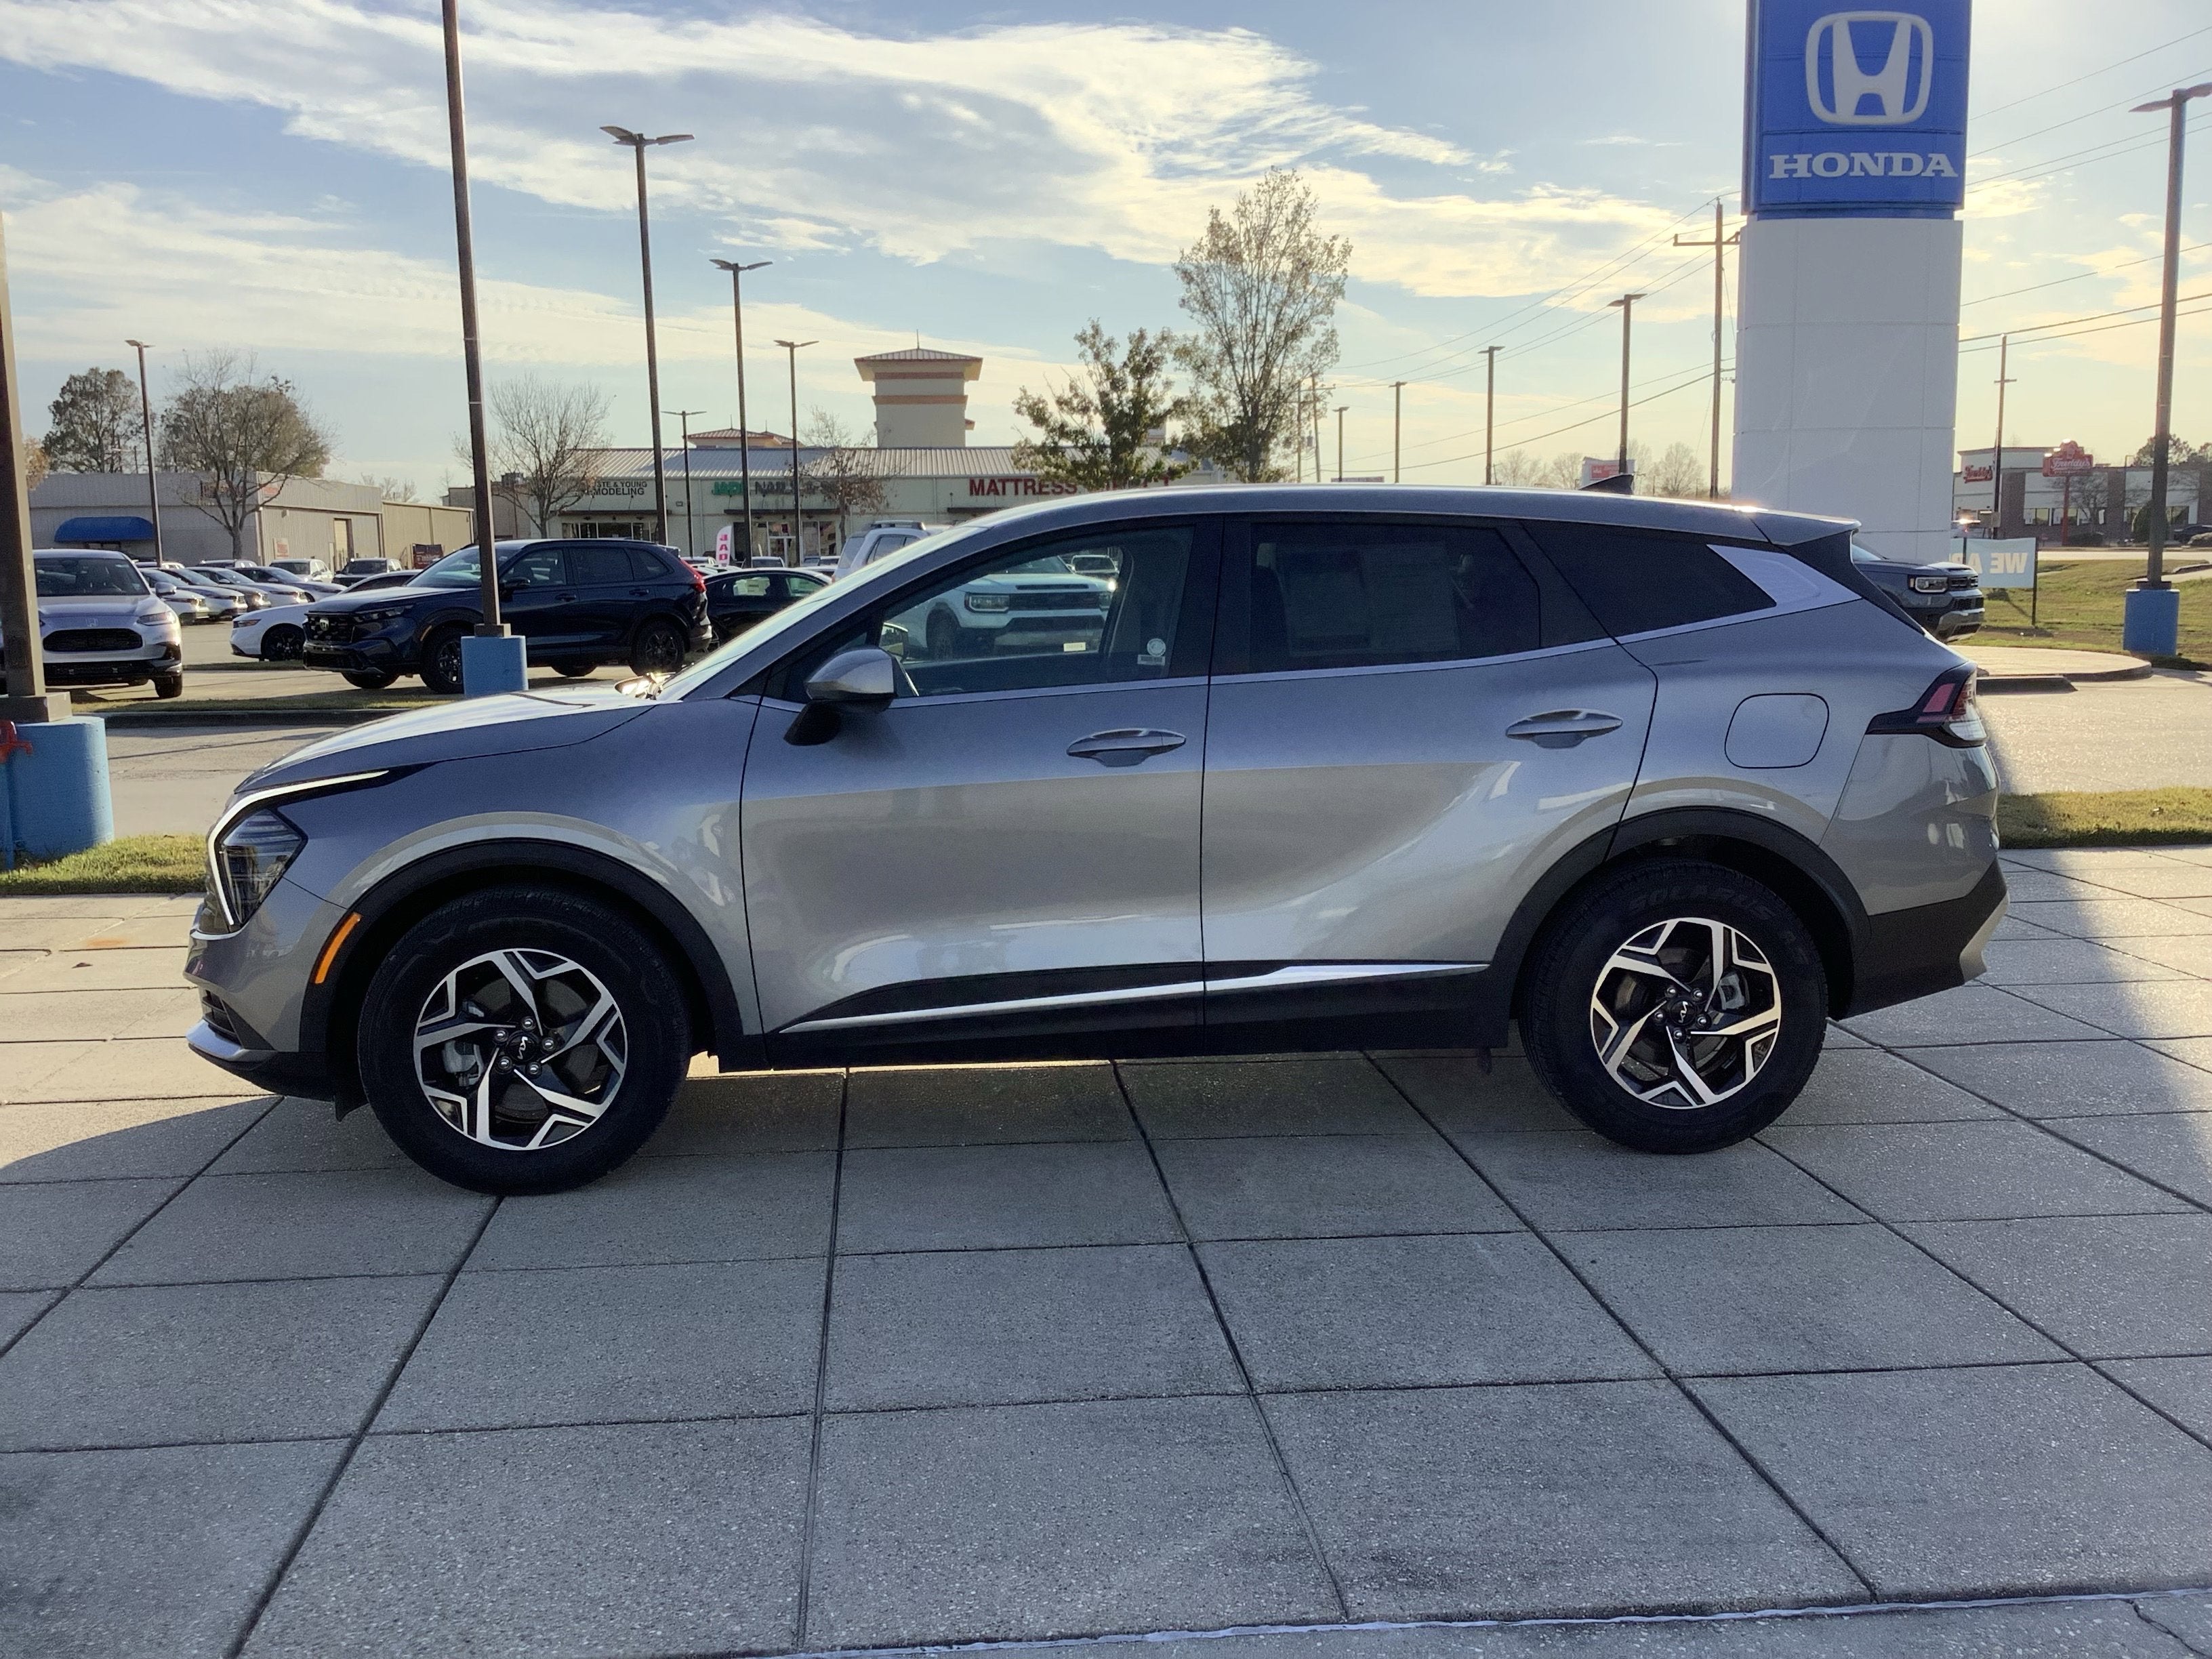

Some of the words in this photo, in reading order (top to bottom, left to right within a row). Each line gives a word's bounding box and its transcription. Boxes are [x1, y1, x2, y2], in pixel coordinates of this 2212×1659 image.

[1769, 152, 1959, 179] HONDA
[586, 487, 644, 495] MODELING
[712, 481, 744, 495] JAD
[969, 477, 1078, 496] MATTRESS
